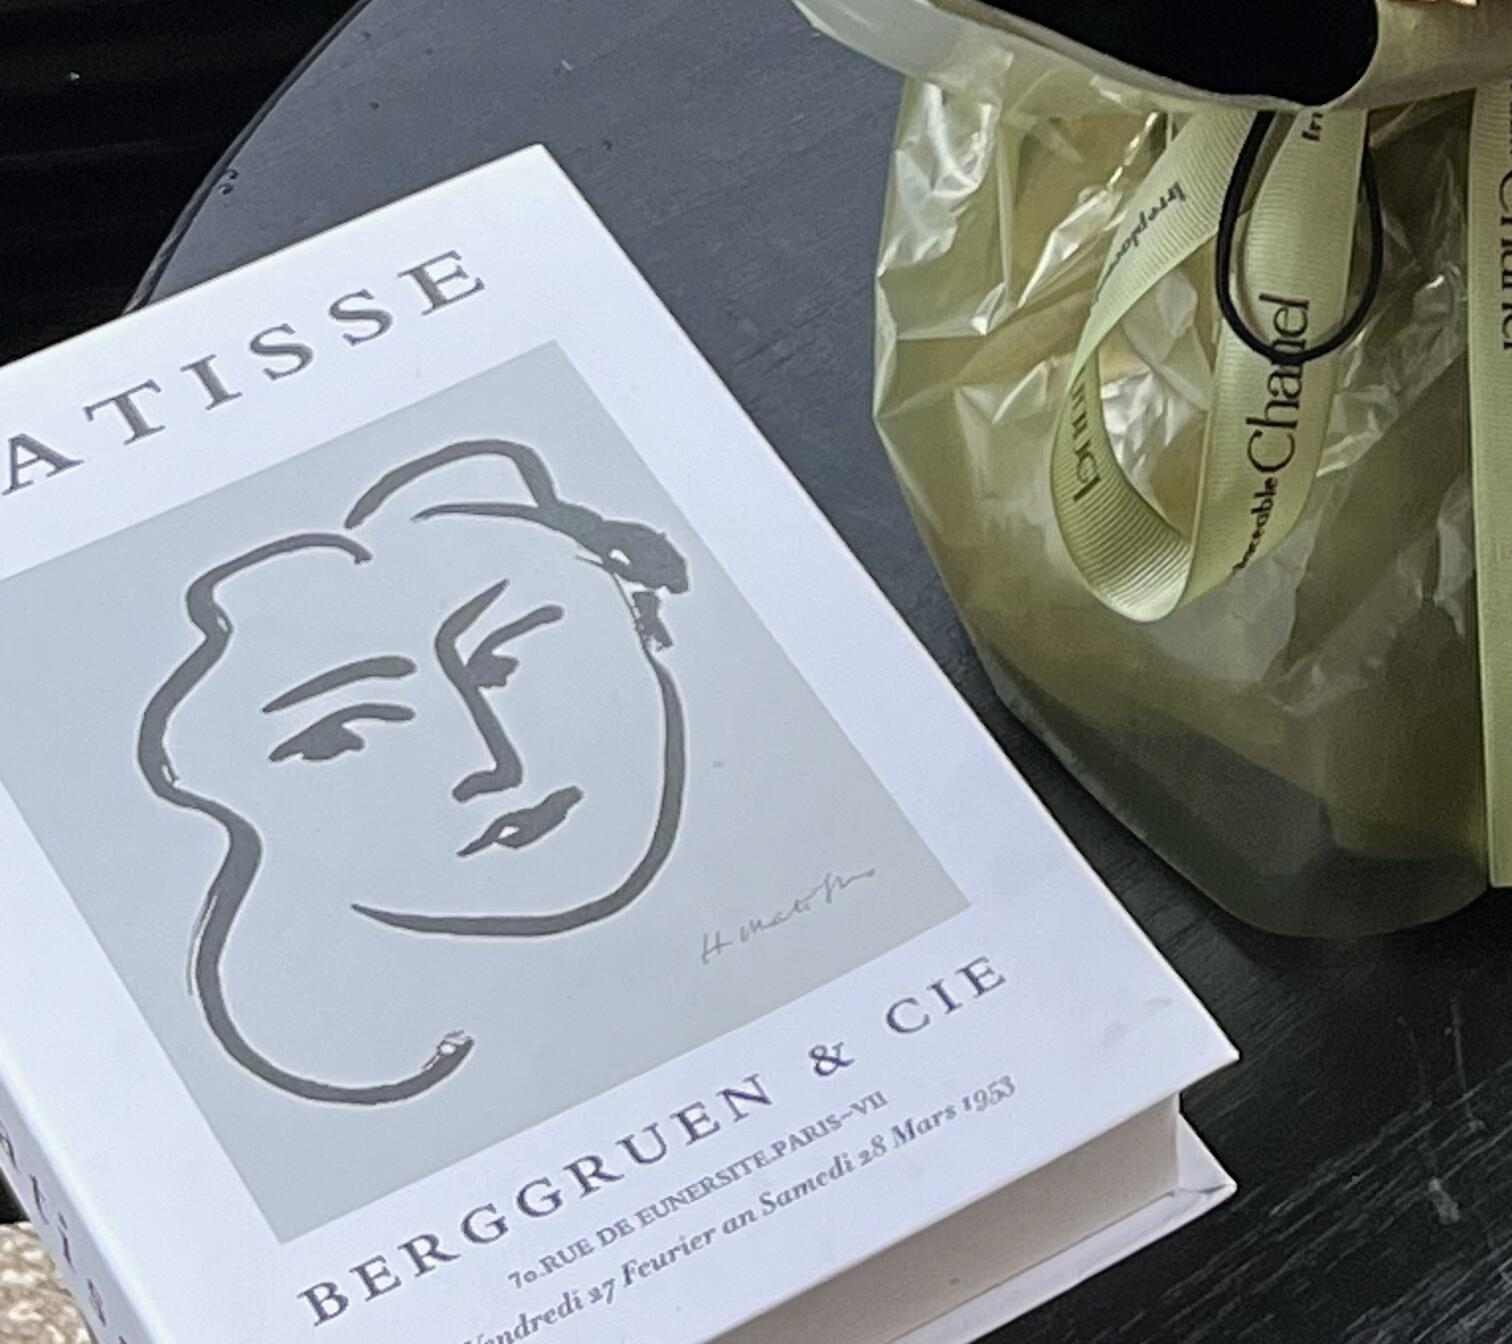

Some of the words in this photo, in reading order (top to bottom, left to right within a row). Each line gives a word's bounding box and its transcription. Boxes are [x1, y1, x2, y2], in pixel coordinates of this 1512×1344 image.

[1, 250, 486, 496] ATISSE
[297, 1073, 773, 1326] BERGGRUEN
[808, 1041, 856, 1078] &
[885, 955, 1007, 1035] CIE
[596, 1218, 636, 1248] DE
[758, 1152, 855, 1218] Samedi
[857, 1133, 888, 1167] 28
[892, 1103, 957, 1150] Mars
[961, 1074, 1018, 1115] 1953
